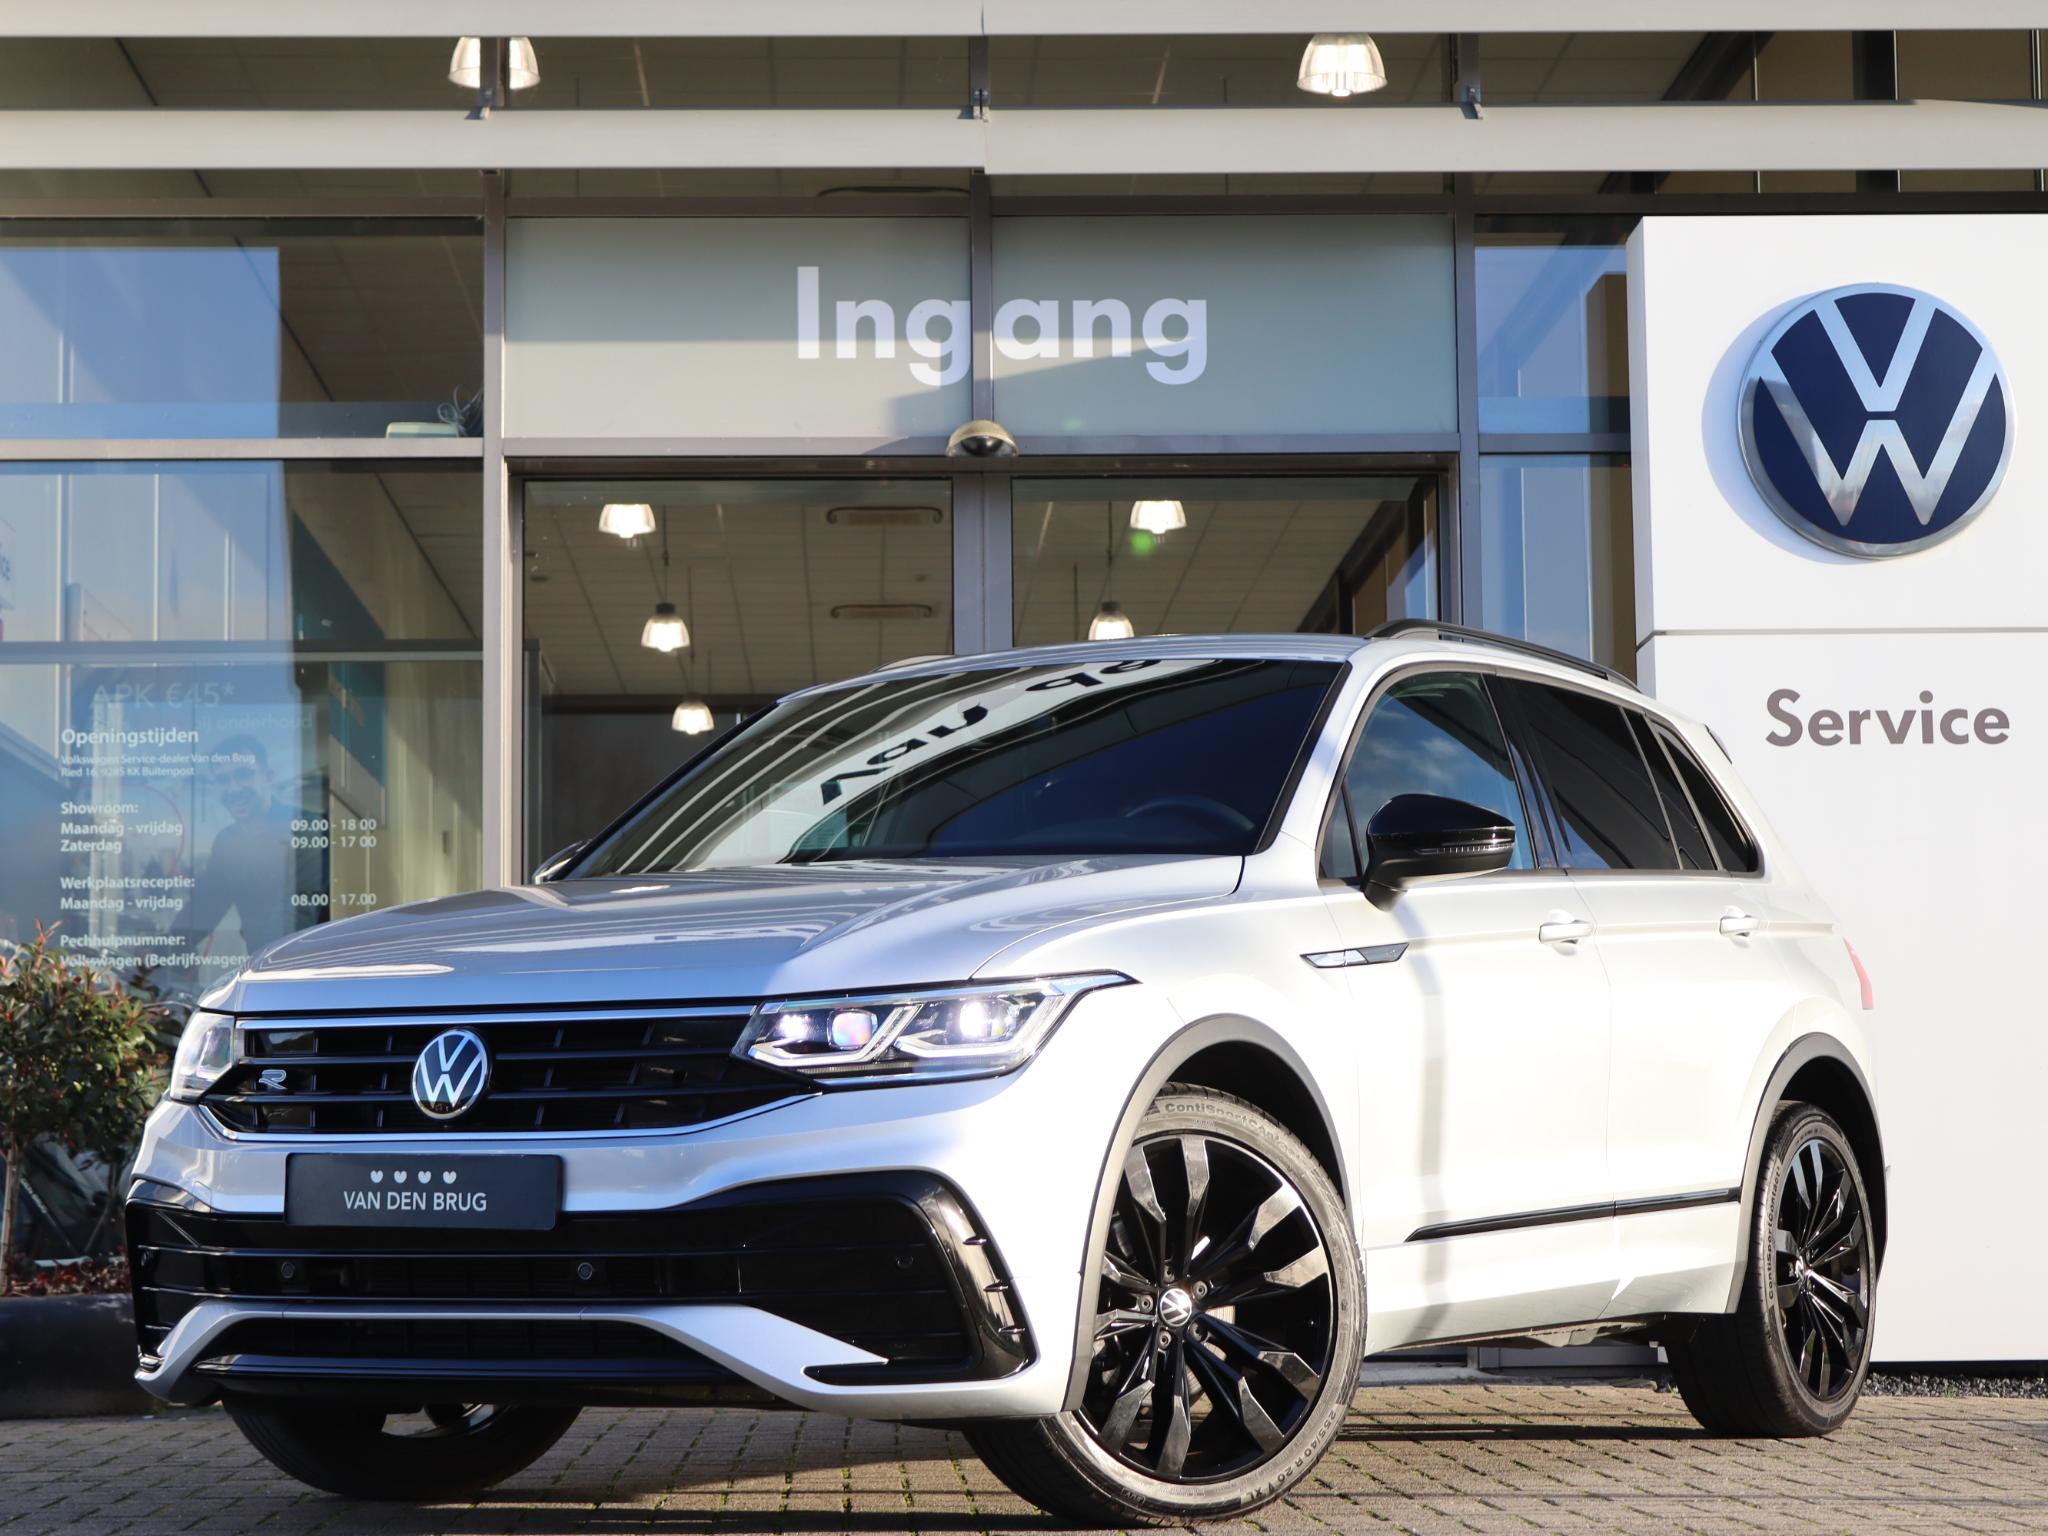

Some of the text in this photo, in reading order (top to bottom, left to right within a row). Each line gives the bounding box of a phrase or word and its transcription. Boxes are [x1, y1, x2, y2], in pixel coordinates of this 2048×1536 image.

[797, 266, 1207, 386] Ingang
[91, 683, 155, 709] APK
[1765, 688, 2011, 747] Service
[61, 728, 199, 748] Openingstijden
[211, 753, 231, 763] den
[61, 802, 139, 814] Showroom:
[60, 822, 124, 837] Maandag
[136, 821, 184, 836] vrijdag
[291, 819, 329, 831] 09.00
[60, 839, 122, 854] Zaterdag
[291, 836, 329, 848] 09.00
[60, 876, 195, 891] Werkplaatsreceptie:
[60, 897, 124, 912] Maandag
[135, 896, 184, 911] vrijdag
[291, 894, 329, 906] 08.00
[341, 893, 377, 905] 17.00
[60, 934, 186, 949] Pechhulpnummer:
[344, 1191, 487, 1211] VAN DEN BRUG
